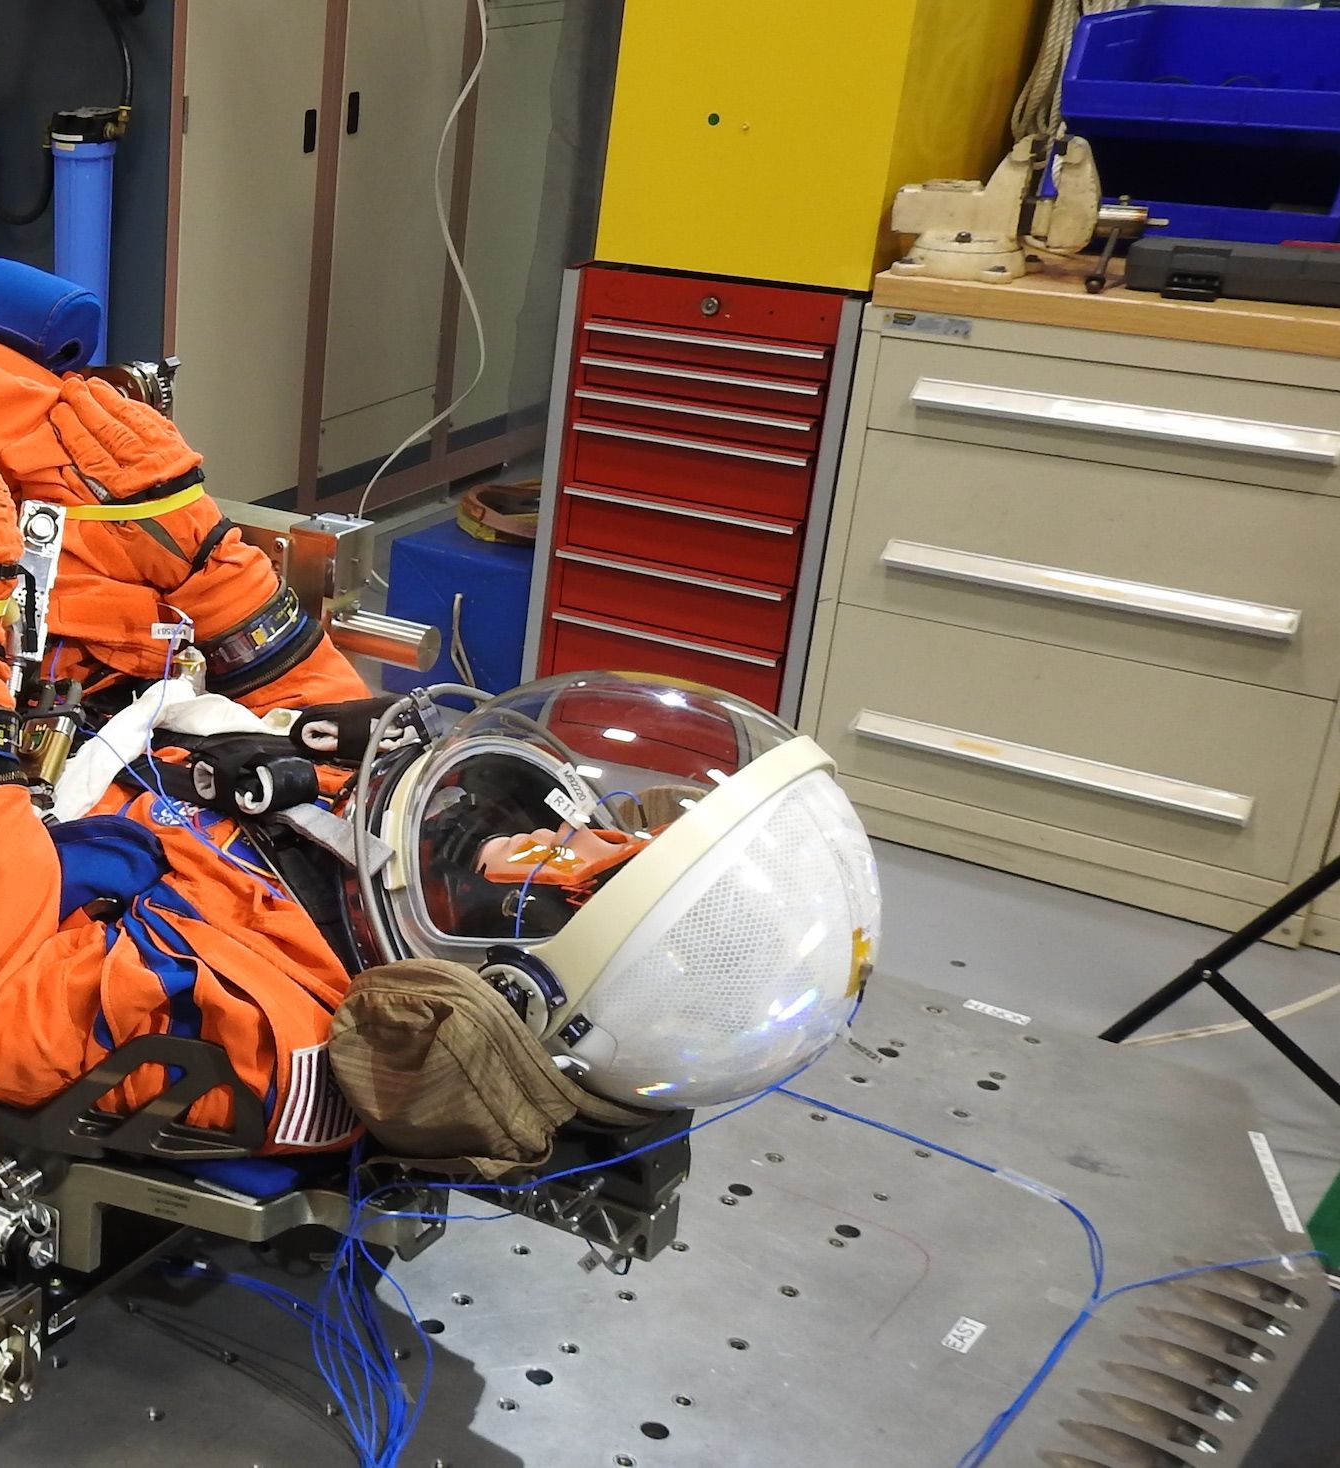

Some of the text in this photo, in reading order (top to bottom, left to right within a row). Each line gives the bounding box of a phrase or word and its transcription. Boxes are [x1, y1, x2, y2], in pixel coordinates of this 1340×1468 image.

[563, 768, 587, 802] M92220
[553, 795, 577, 818] R11
[946, 1319, 979, 1350] EAST
